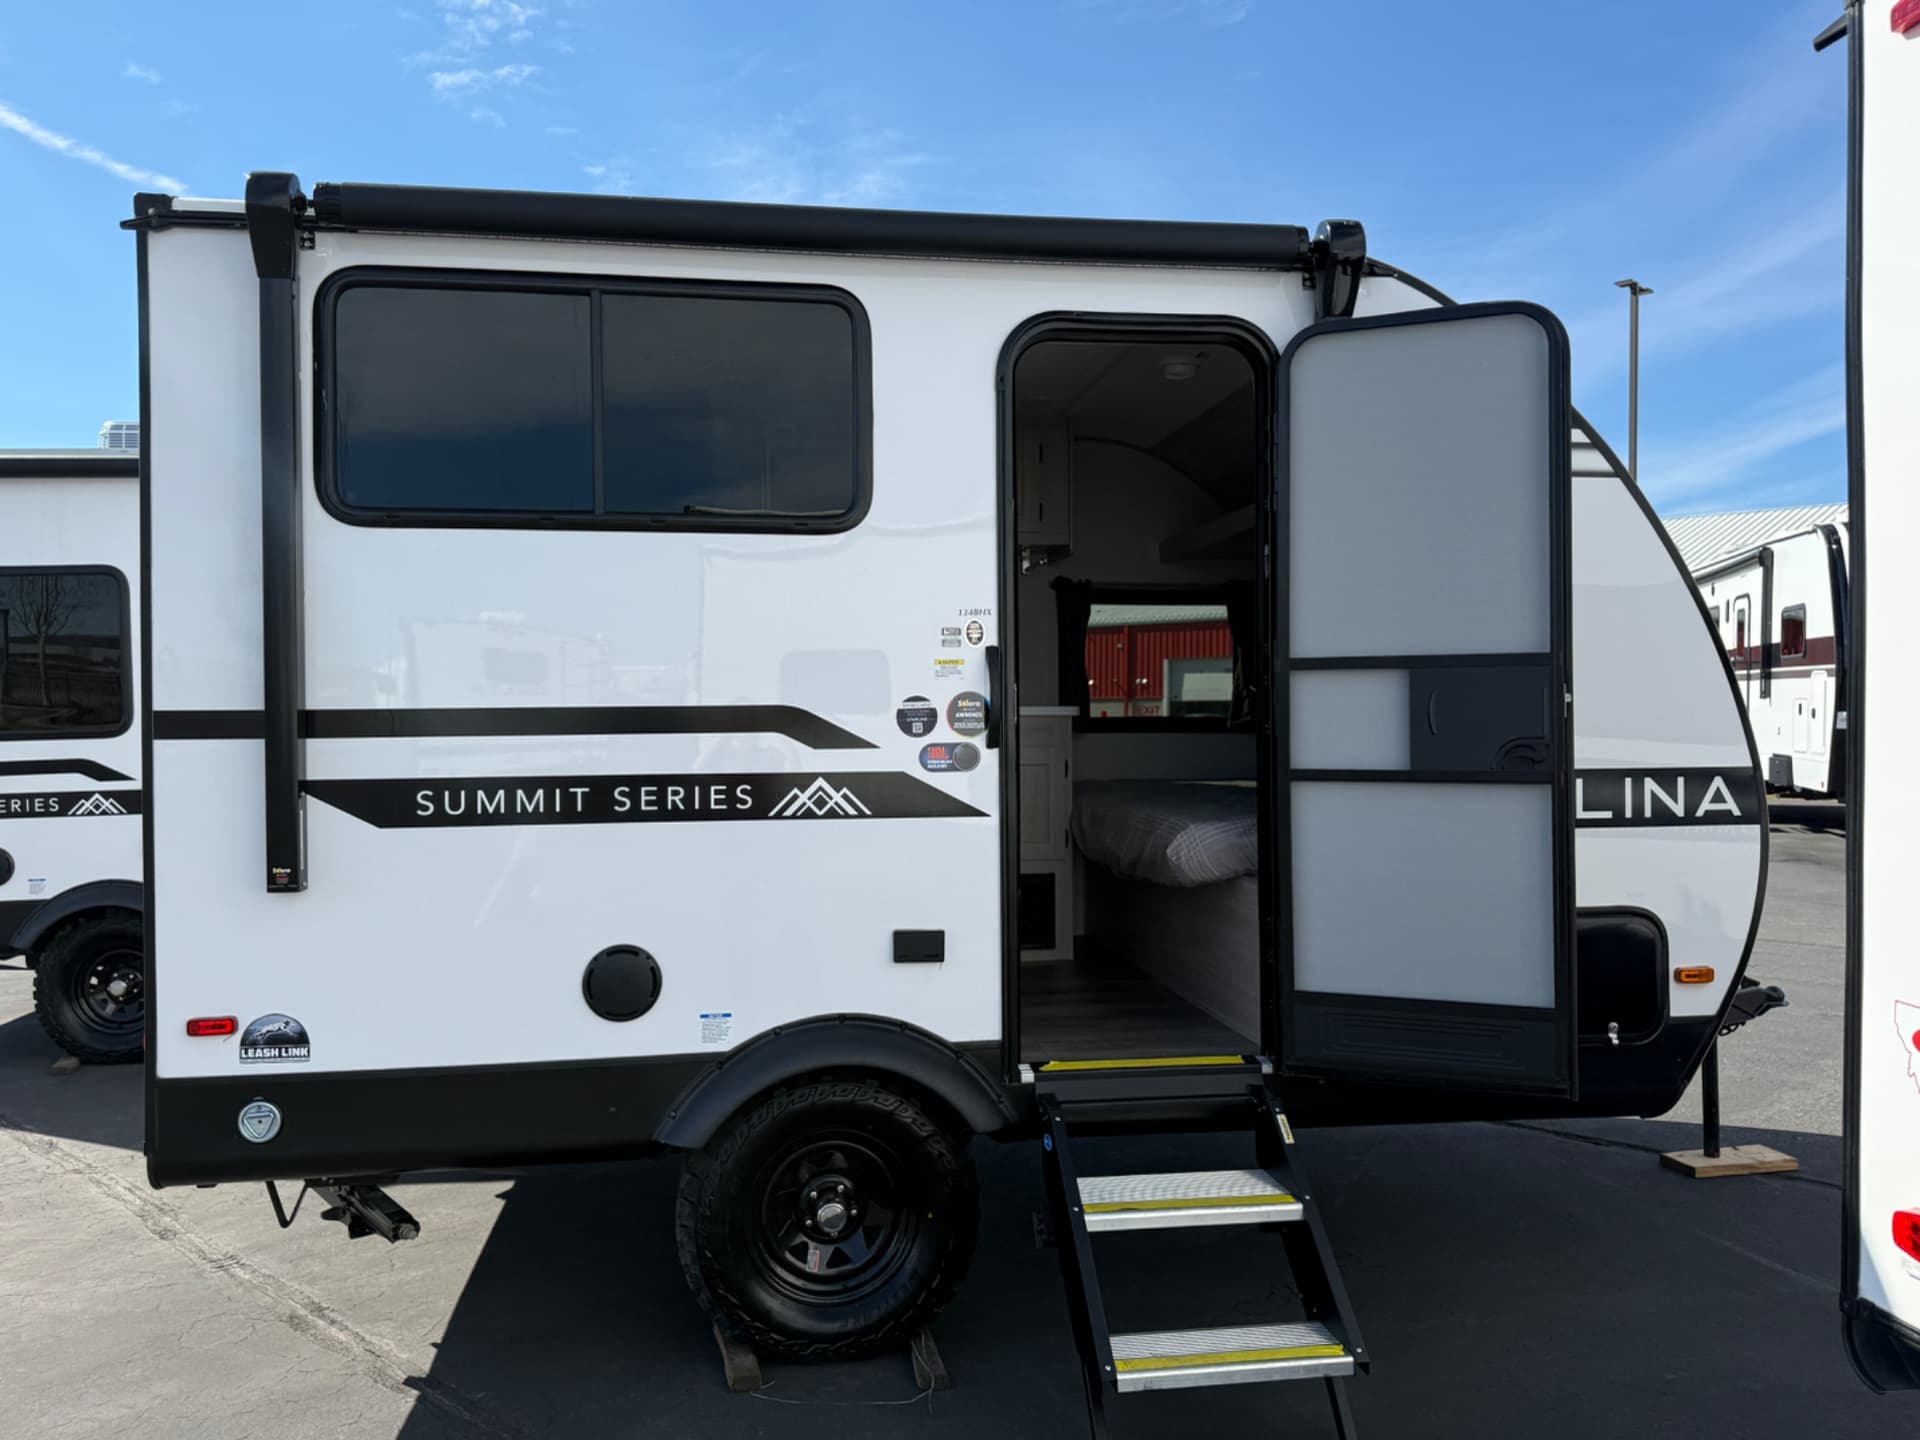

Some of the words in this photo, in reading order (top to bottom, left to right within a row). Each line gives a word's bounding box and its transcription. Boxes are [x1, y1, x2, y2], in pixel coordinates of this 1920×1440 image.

[0, 797, 59, 814] ERIES
[416, 787, 591, 816] SUMMIT
[613, 784, 753, 812] SERIES
[1575, 776, 1742, 819] LINA
[241, 1047, 279, 1058] LEASH
[281, 1047, 309, 1057] LINK
